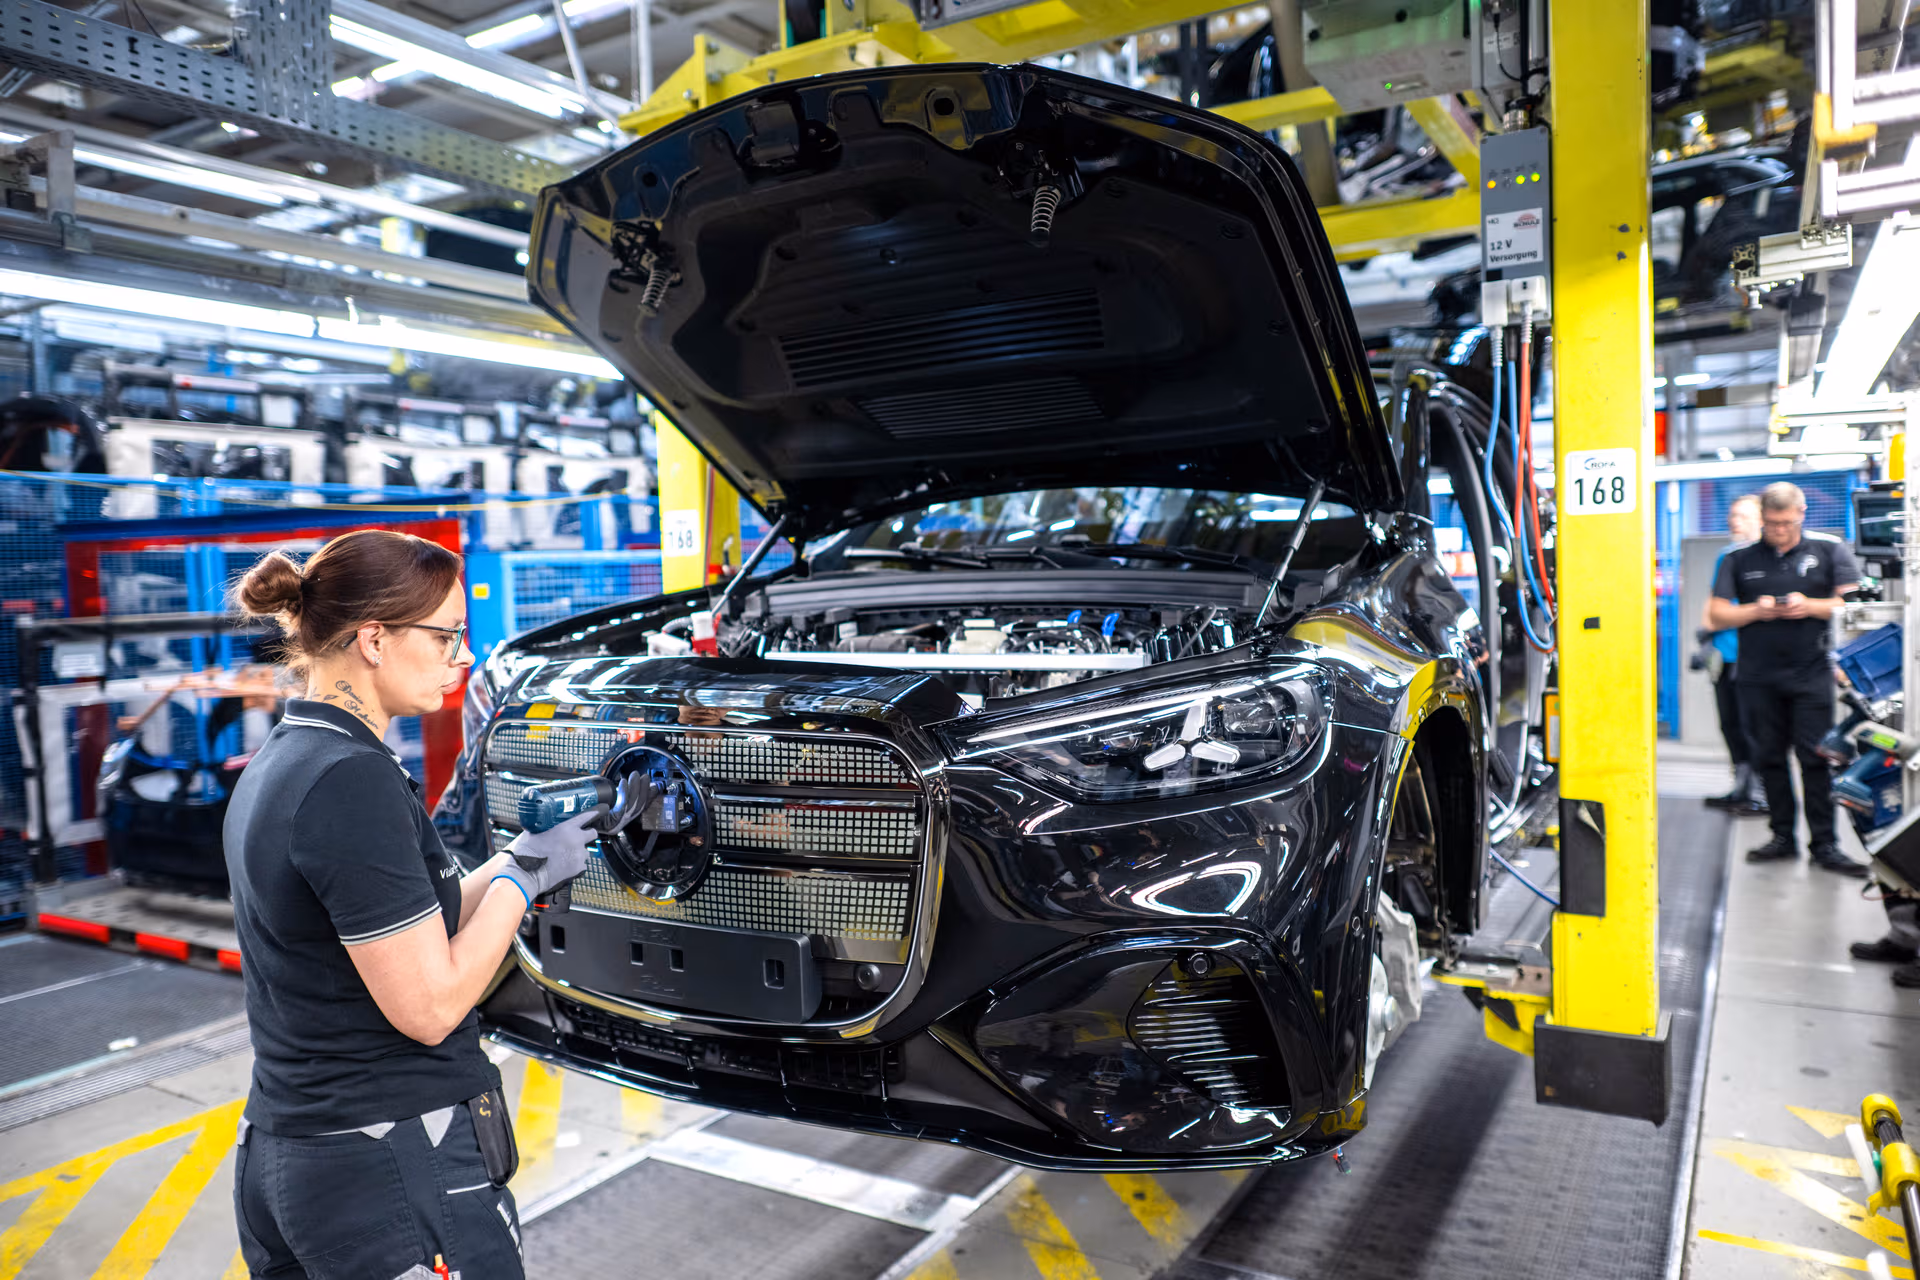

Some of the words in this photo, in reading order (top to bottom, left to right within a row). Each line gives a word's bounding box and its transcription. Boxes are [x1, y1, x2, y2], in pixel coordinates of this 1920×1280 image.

[1490, 240, 1503, 251] 12
[1505, 238, 1512, 249] V
[1489, 250, 1538, 262] Versorgung
[1574, 475, 1625, 506] 168
[666, 529, 693, 549] 168
